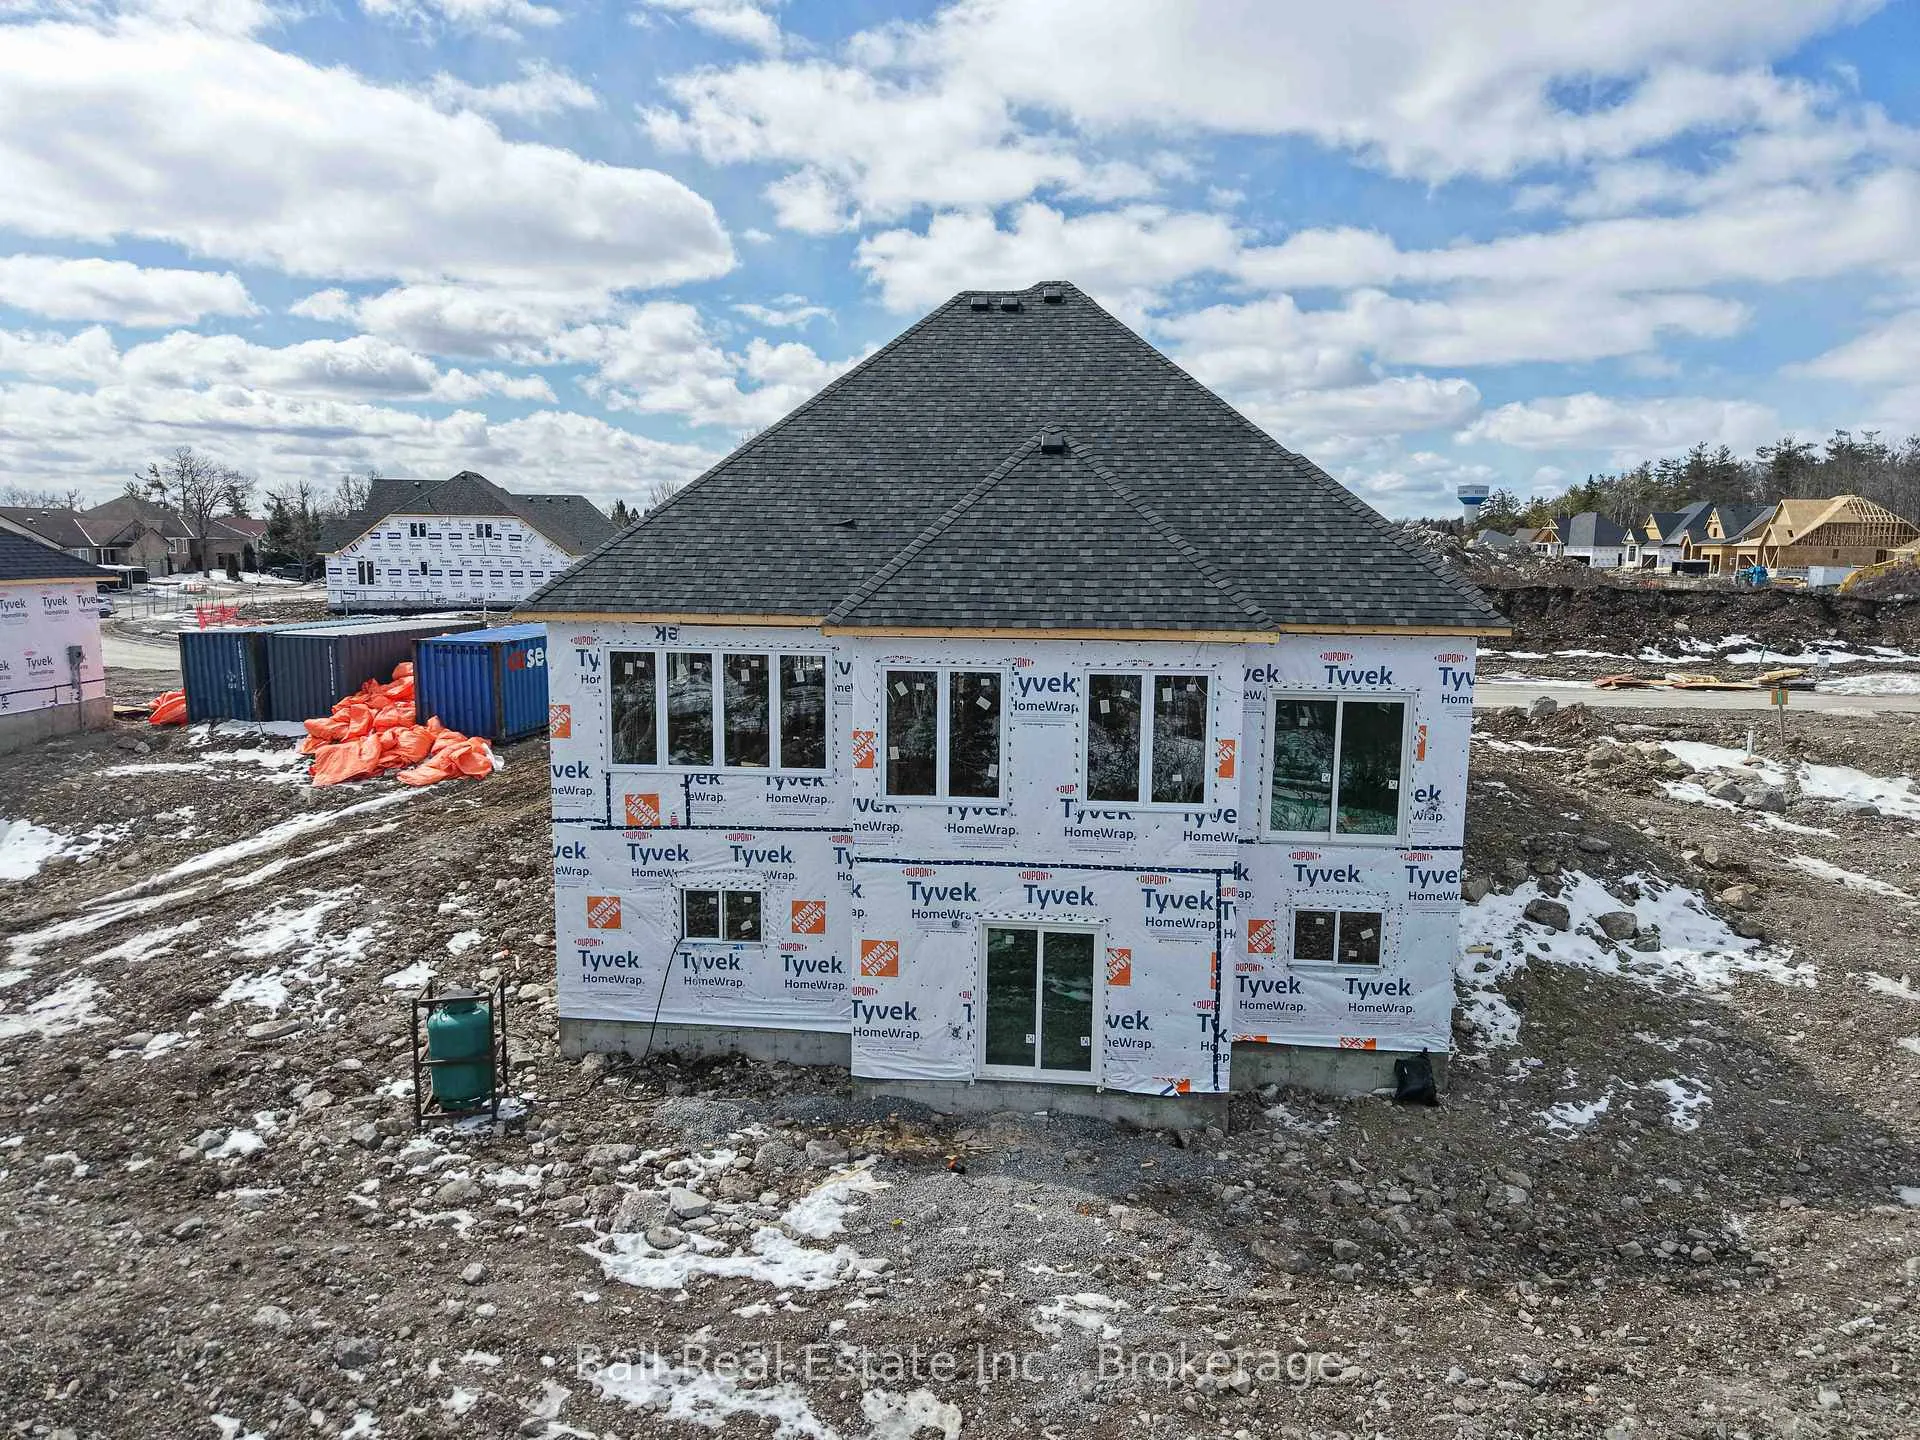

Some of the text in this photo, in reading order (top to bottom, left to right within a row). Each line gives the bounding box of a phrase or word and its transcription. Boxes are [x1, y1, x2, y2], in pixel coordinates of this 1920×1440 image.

[1323, 652, 1350, 661] DUPONT
[1438, 653, 1464, 663] DUPONT
[1325, 665, 1393, 685] Tyvek
[766, 793, 828, 805] HomeWrap
[625, 831, 649, 841] DUPONT
[947, 823, 1016, 837] HomeWrap
[1064, 827, 1134, 841] HomeWrap
[728, 833, 752, 842] DUPONT
[627, 843, 690, 865] Tyvek
[730, 845, 793, 867] Tyvek
[1292, 851, 1319, 861] DUPONT
[905, 867, 932, 877] DUPONT
[1022, 871, 1049, 880] DUPONT
[1293, 864, 1361, 887] Tyvek
[1140, 875, 1168, 885] DUPONT
[907, 881, 977, 906] Tyvek
[1024, 884, 1095, 910] Tyvek
[1142, 888, 1214, 914] Tyvek
[1145, 916, 1216, 931] HomeWrap
[577, 938, 601, 947] DUPONT
[780, 943, 805, 952] DUPONT
[578, 950, 640, 972] Tyvek
[680, 952, 741, 974] Tyvek
[781, 955, 843, 977] Tyvek
[1235, 963, 1261, 972] DUPONT
[583, 974, 642, 986] HomeWrap
[785, 979, 845, 991] HomeWrap
[1235, 975, 1302, 998] Tyvek
[1345, 977, 1411, 1000] Tyvek
[852, 1000, 917, 1024] Tyvek
[1240, 1000, 1304, 1013] HomeWrap
[1348, 1003, 1413, 1015] HomeWrap
[853, 1026, 920, 1041] HomeWrap
